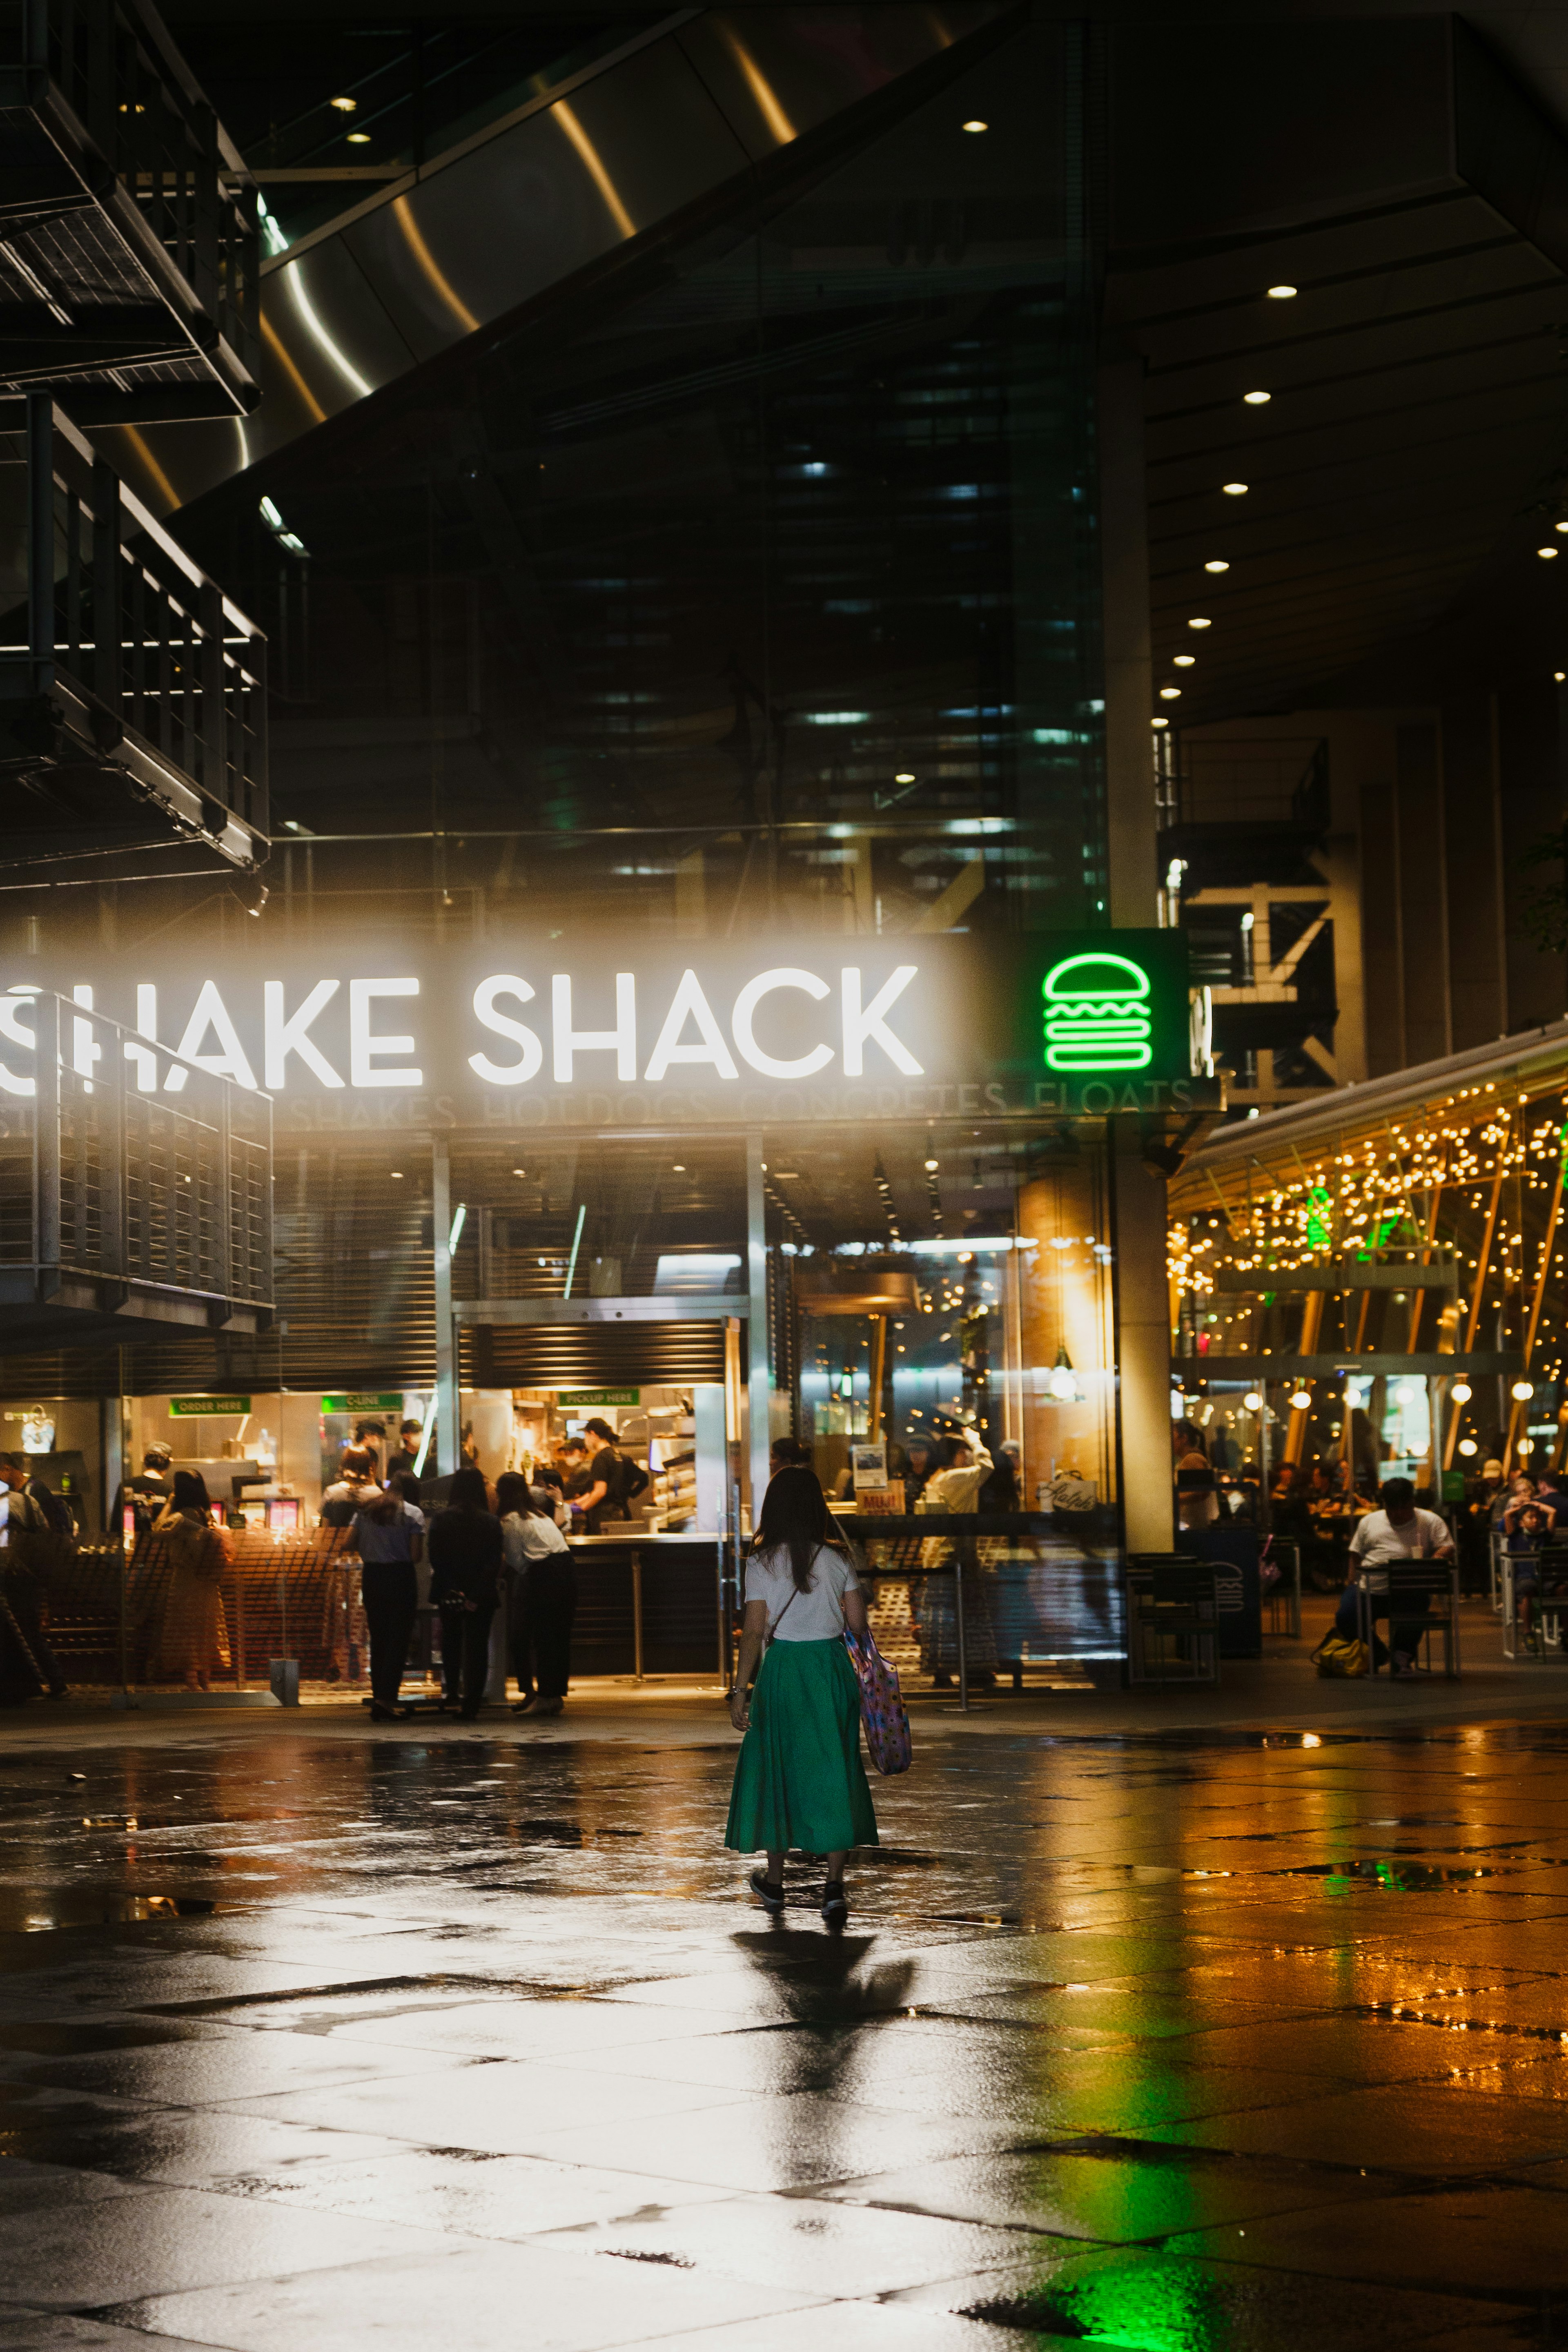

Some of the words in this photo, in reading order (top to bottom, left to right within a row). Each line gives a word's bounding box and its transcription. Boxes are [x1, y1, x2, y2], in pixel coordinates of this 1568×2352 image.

[468, 965, 925, 1085] SHACK
[1034, 1079, 1192, 1113] FLOATS
[179, 1402, 214, 1411] ORDER
[216, 1401, 242, 1411] HERE
[606, 1393, 632, 1402] HERE
